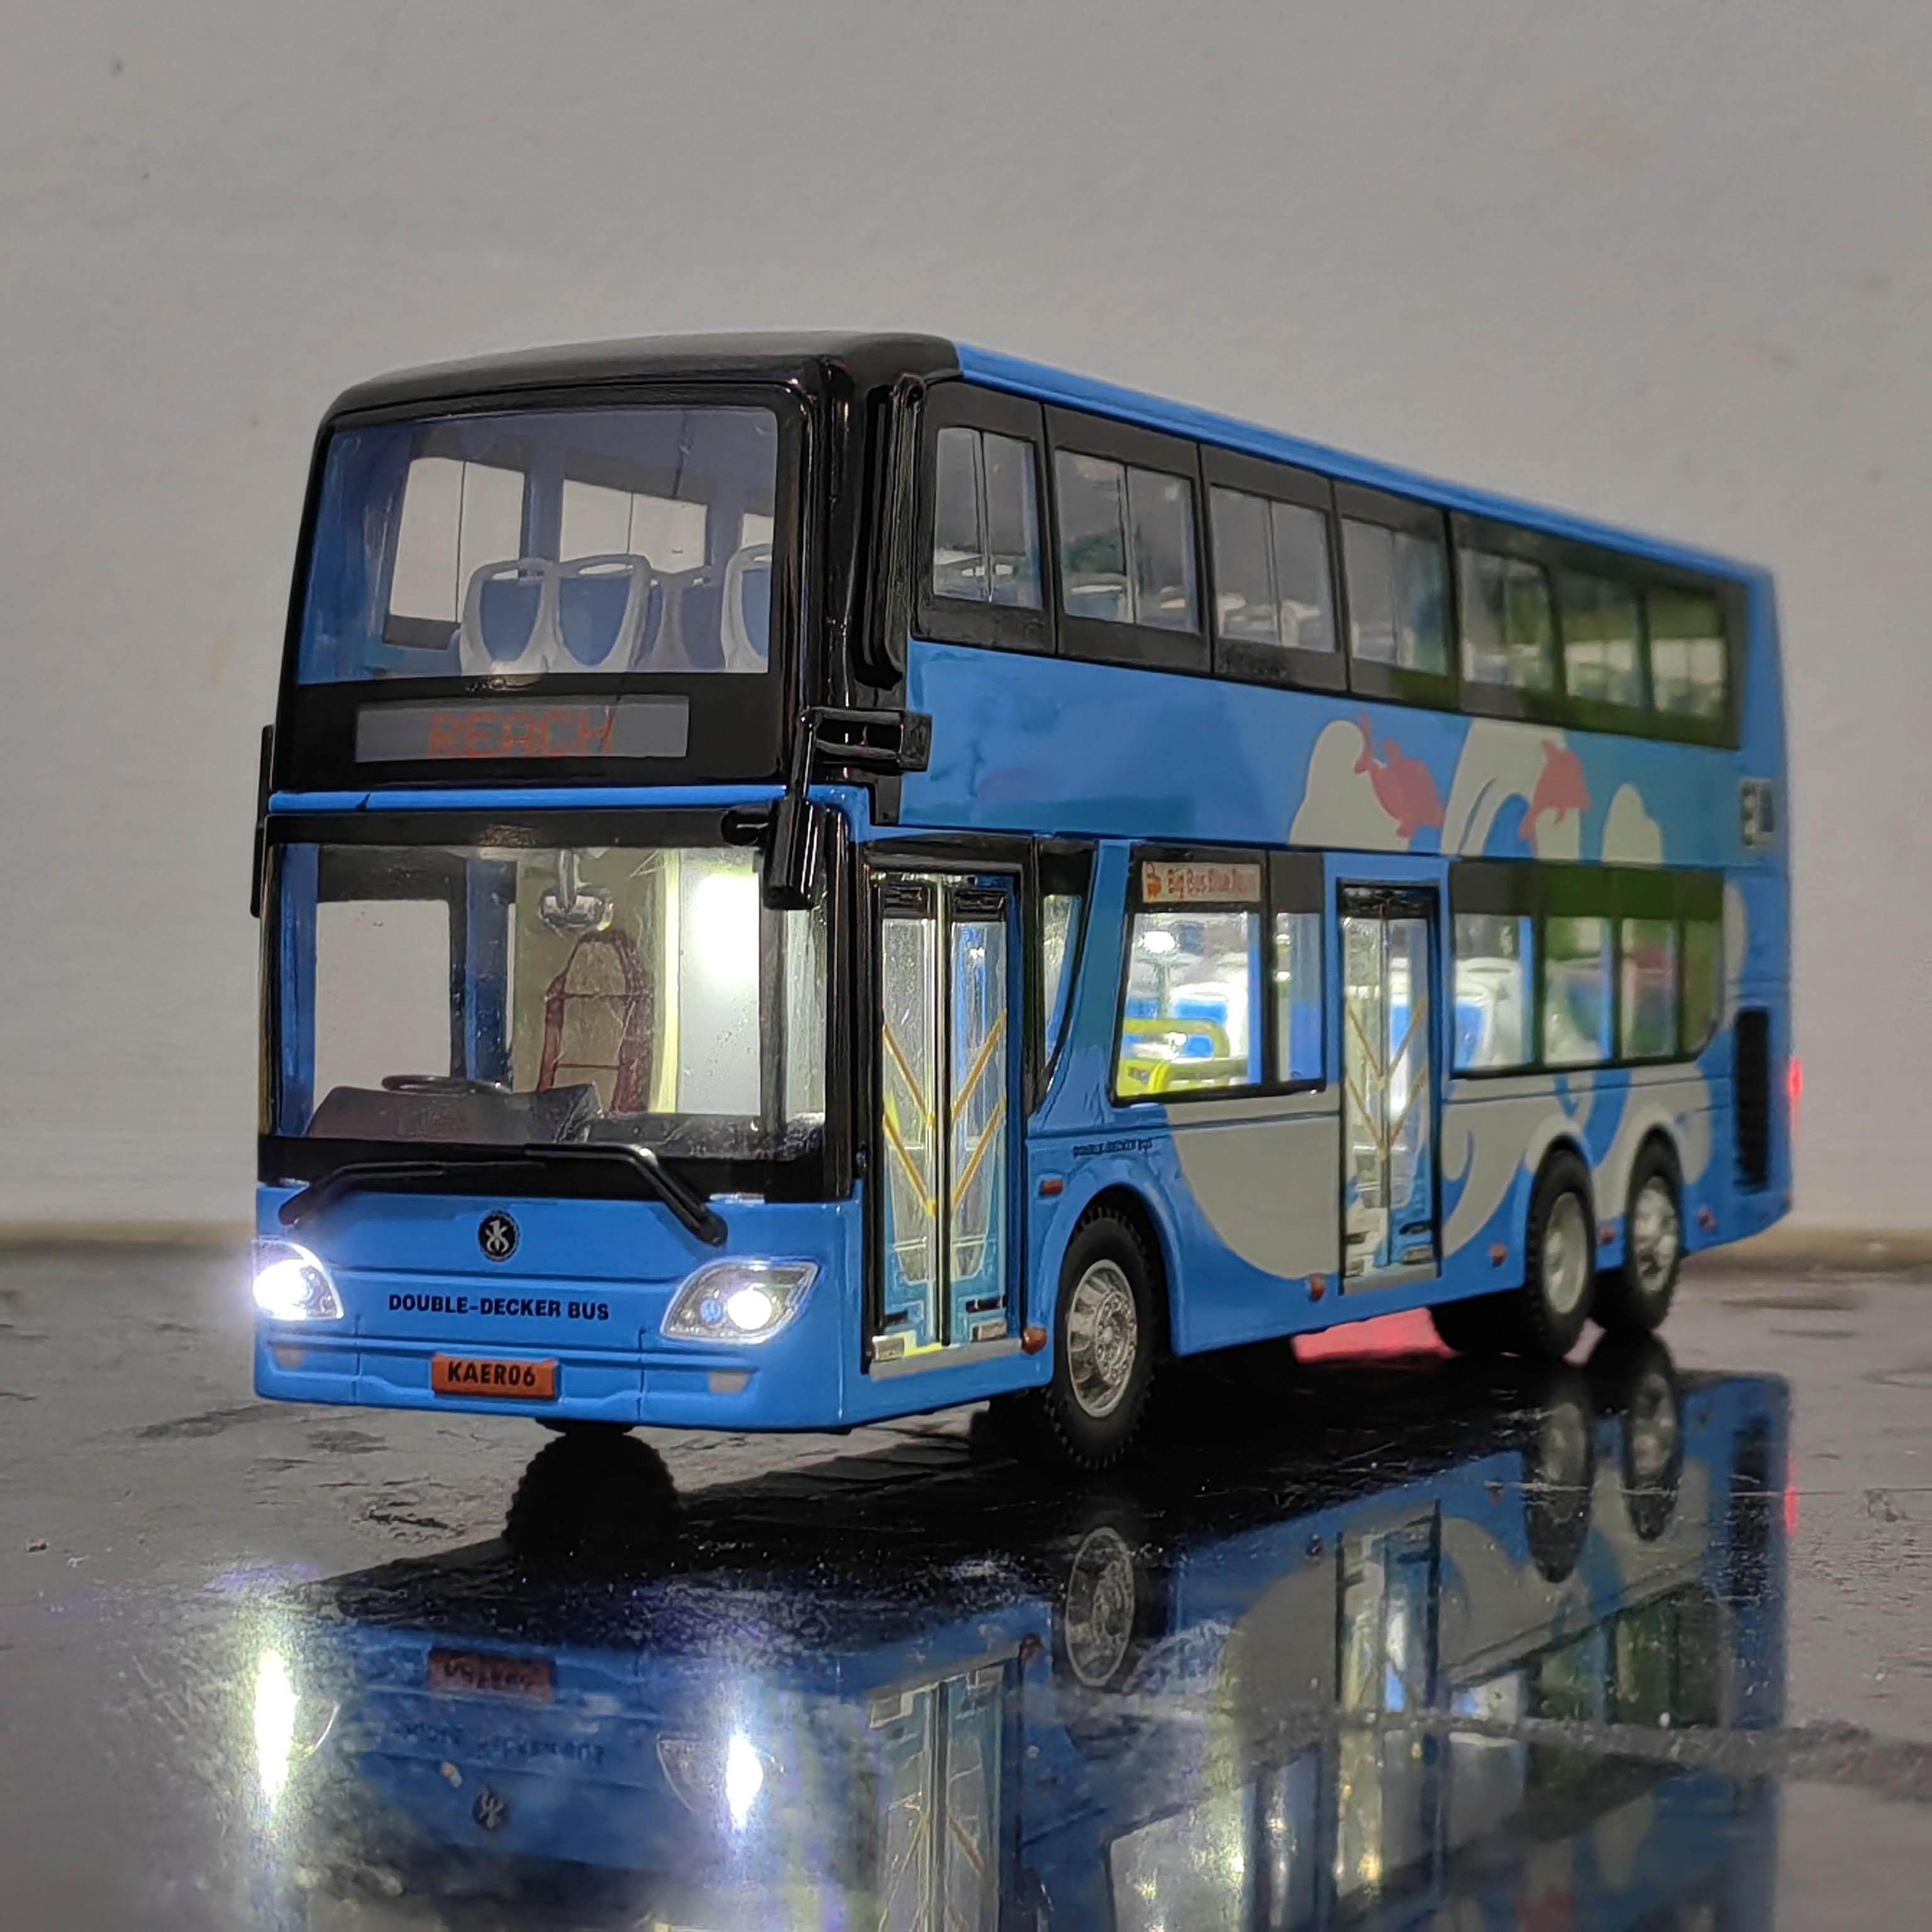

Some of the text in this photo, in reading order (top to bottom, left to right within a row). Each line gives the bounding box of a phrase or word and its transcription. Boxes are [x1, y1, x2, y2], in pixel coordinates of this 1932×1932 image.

[428, 709, 614, 757] REACH
[389, 1294, 609, 1320] DOUBLE-DECKER BUS
[448, 1362, 535, 1386] KAER06
